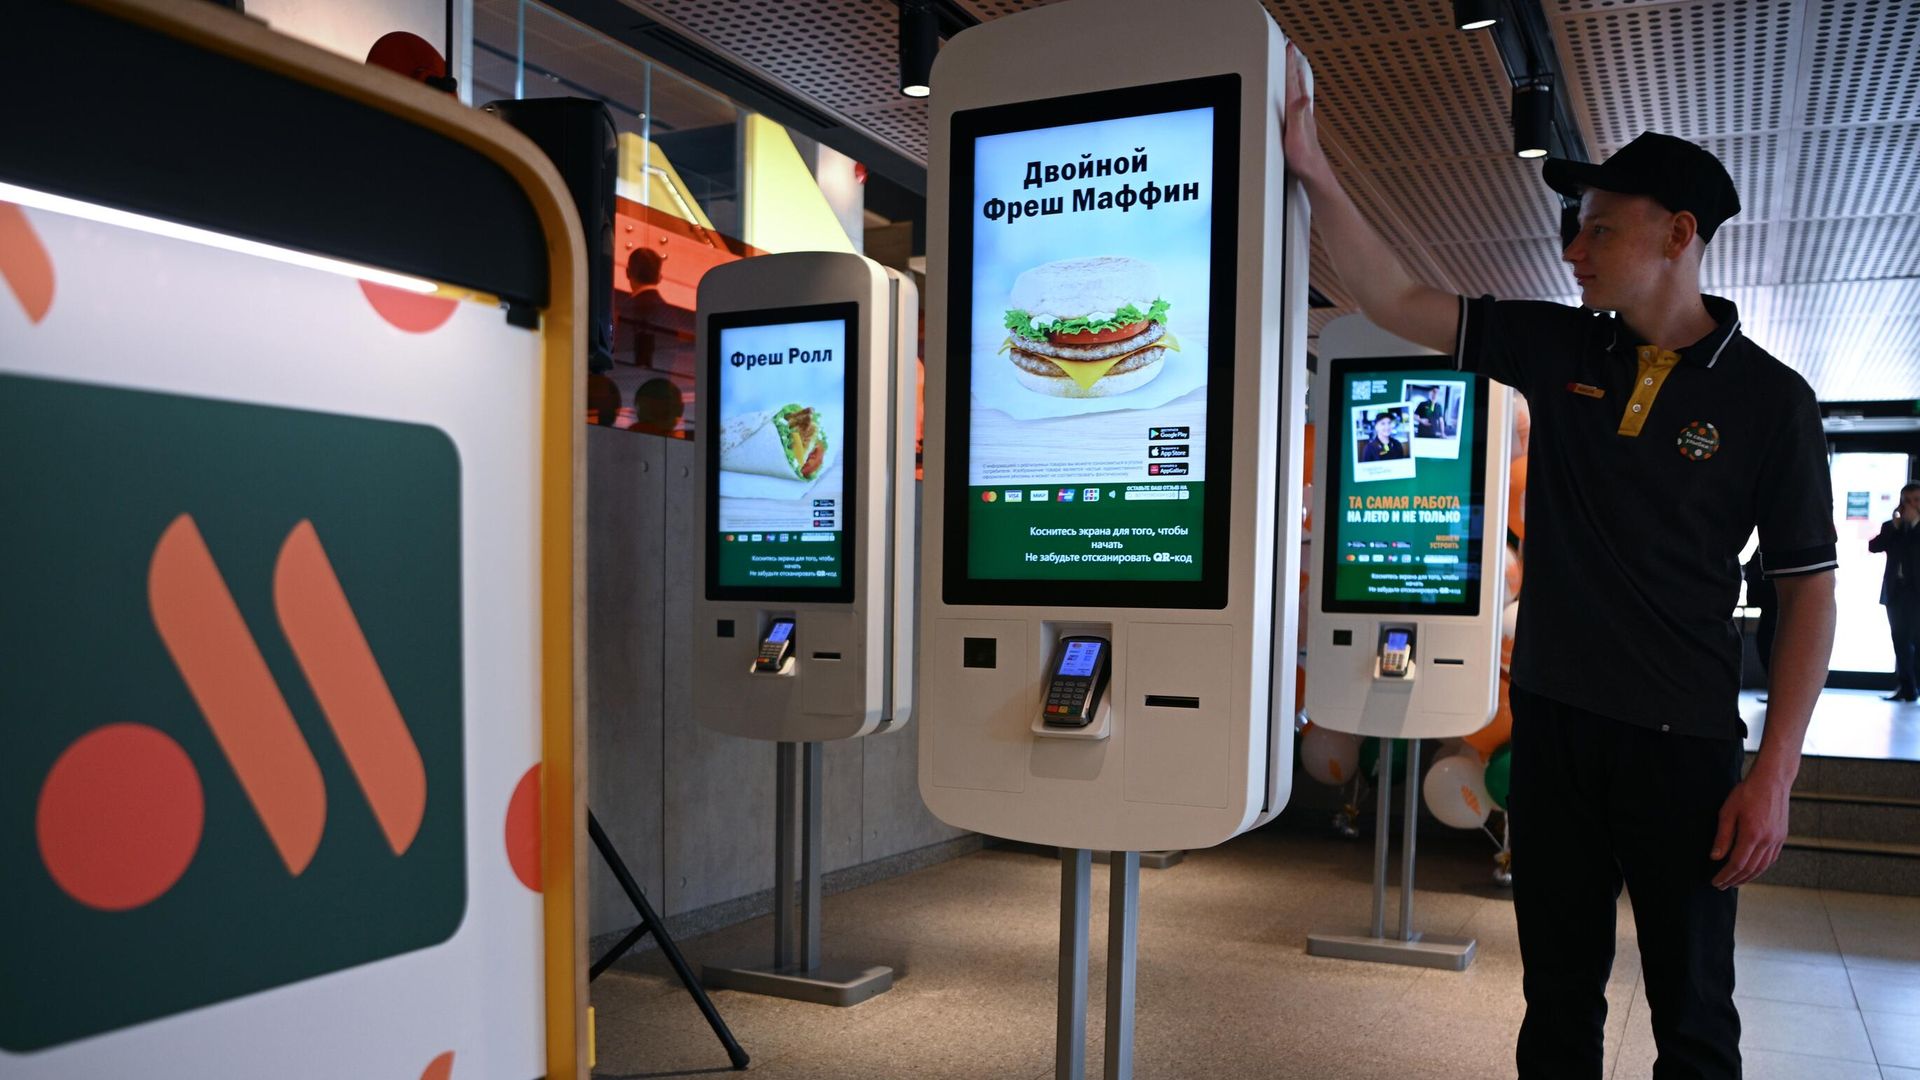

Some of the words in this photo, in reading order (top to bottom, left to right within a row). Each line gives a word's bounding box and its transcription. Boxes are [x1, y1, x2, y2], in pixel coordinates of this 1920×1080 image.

[1023, 146, 1148, 189] Двойной
[983, 196, 1064, 224] Фреш
[1072, 181, 1199, 212] Маффин
[730, 351, 783, 370] Фреш
[788, 347, 833, 364] Ролл
[1349, 496, 1363, 509] ТА
[1366, 496, 1409, 509] САМАЯ
[1413, 496, 1460, 509] РАБОТА
[1347, 510, 1361, 522] НА
[1363, 510, 1390, 522] ЛЕТО
[1402, 510, 1417, 522] НЕ
[1418, 510, 1461, 523] ТОЛЬКО
[1029, 527, 1077, 536] Коснитесь
[1078, 527, 1111, 538] экрана
[1112, 527, 1130, 536] для
[1131, 527, 1156, 537] того,
[1157, 525, 1189, 535] чтобы
[1091, 540, 1123, 549] начать
[1025, 552, 1038, 562] Не
[1039, 551, 1080, 564] забудьте
[1081, 553, 1151, 564] отсканировать
[1152, 552, 1193, 563] QR-код
